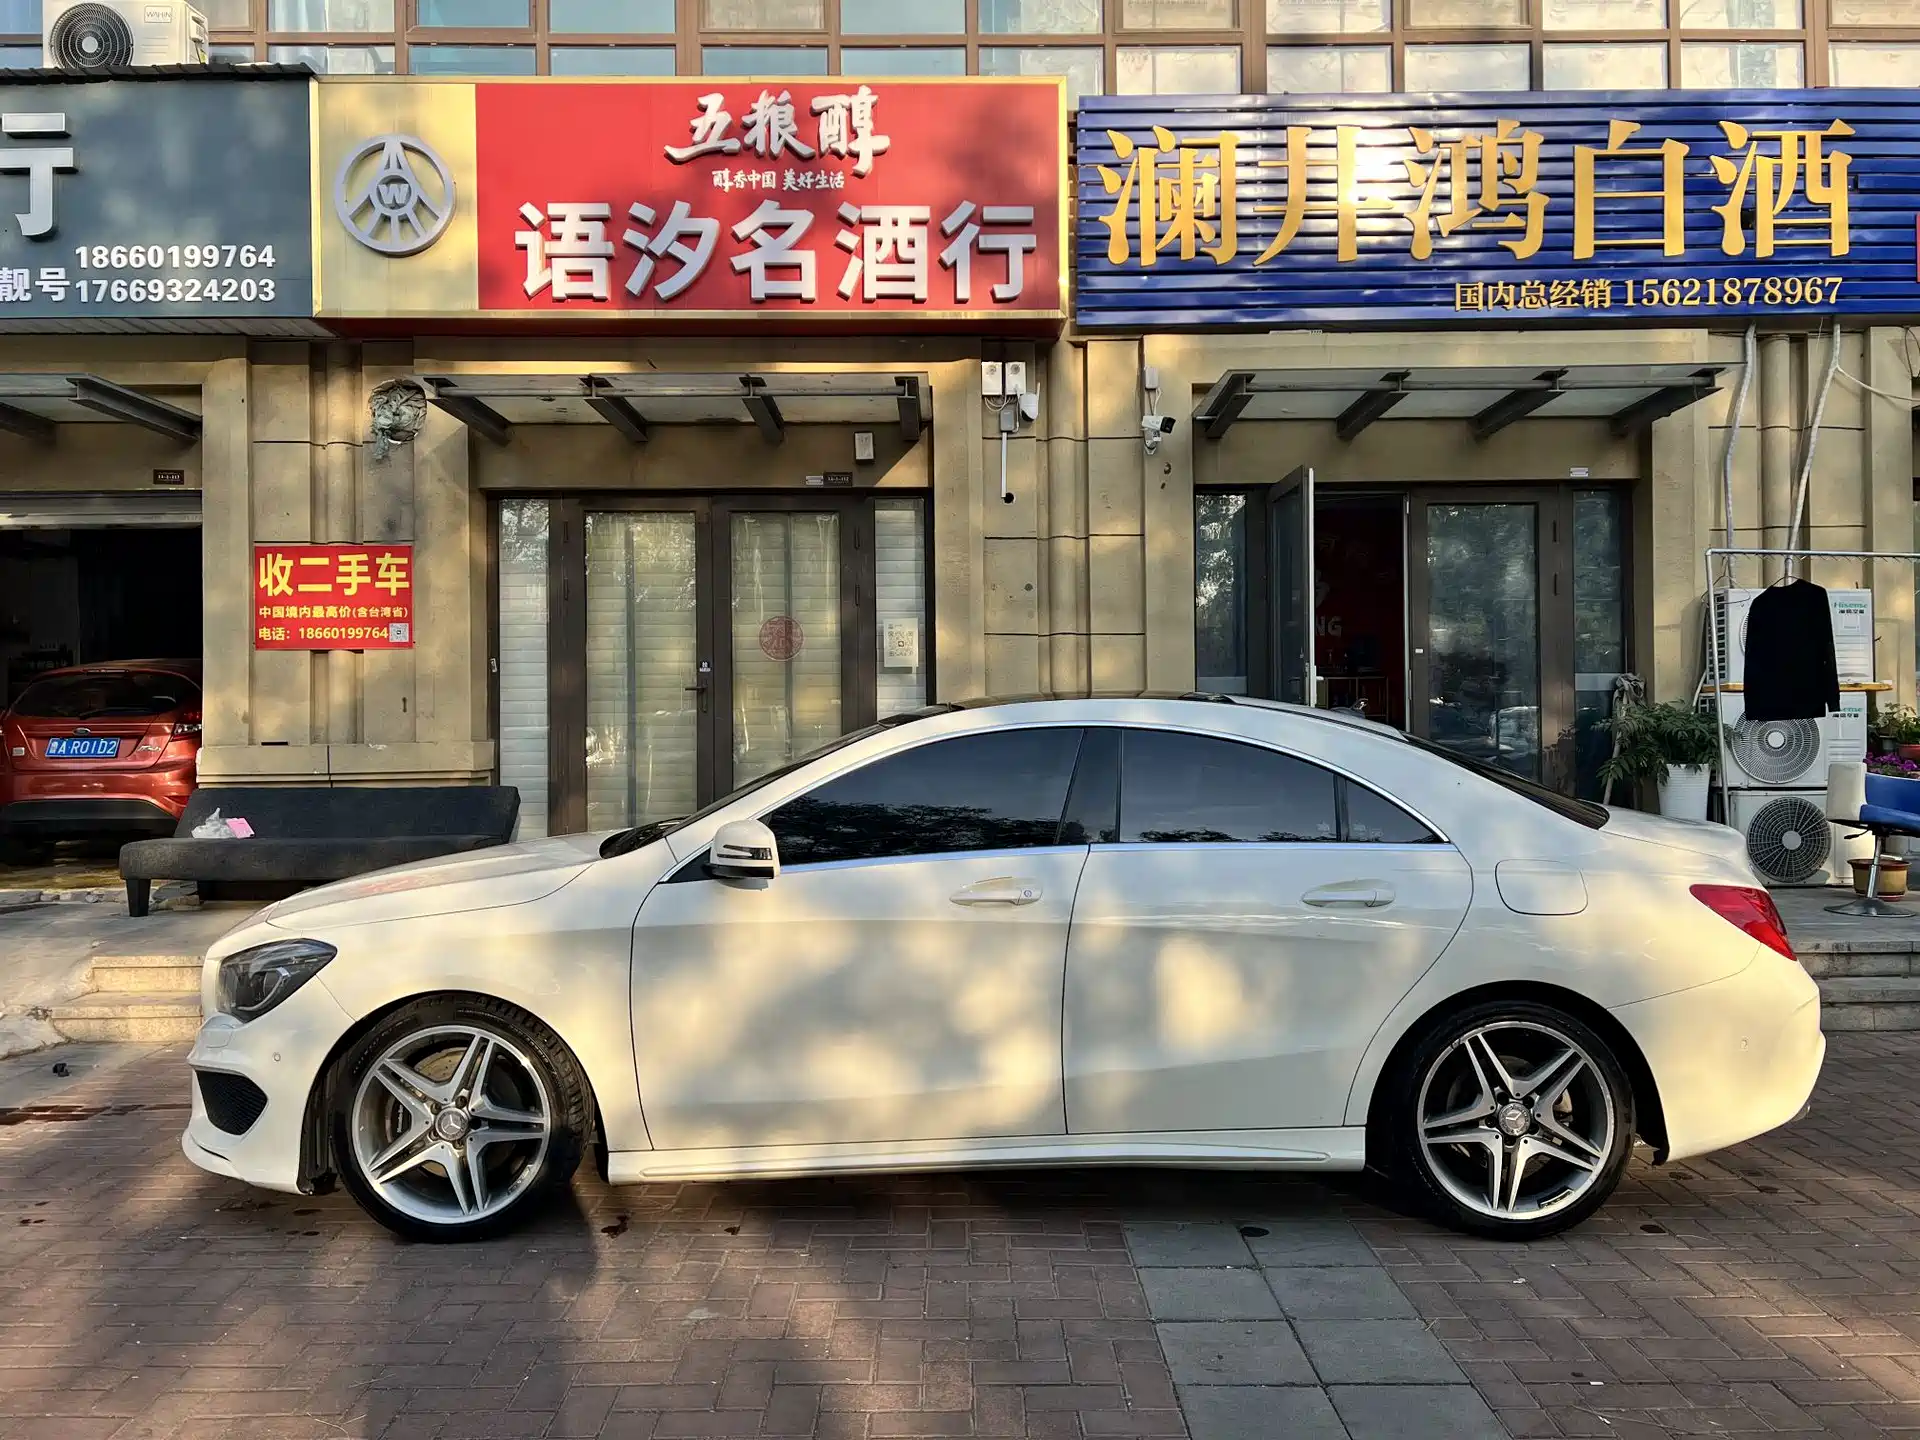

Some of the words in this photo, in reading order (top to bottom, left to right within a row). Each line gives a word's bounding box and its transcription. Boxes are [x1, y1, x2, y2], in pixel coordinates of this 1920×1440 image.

[664, 85, 890, 177] 五粮醇
[712, 167, 777, 193] 醇香中国
[781, 169, 845, 191] 美好生活
[1097, 117, 1856, 267] 澜井鸿白酒
[75, 245, 275, 269] 18660199764
[514, 199, 1037, 300] 语汐名酒行
[0, 267, 70, 302] 靓号
[75, 279, 275, 302] 17669324203
[1454, 279, 1612, 312] 国内总经销
[1624, 276, 1843, 307] 15621878967
[259, 553, 410, 597] 收二手车
